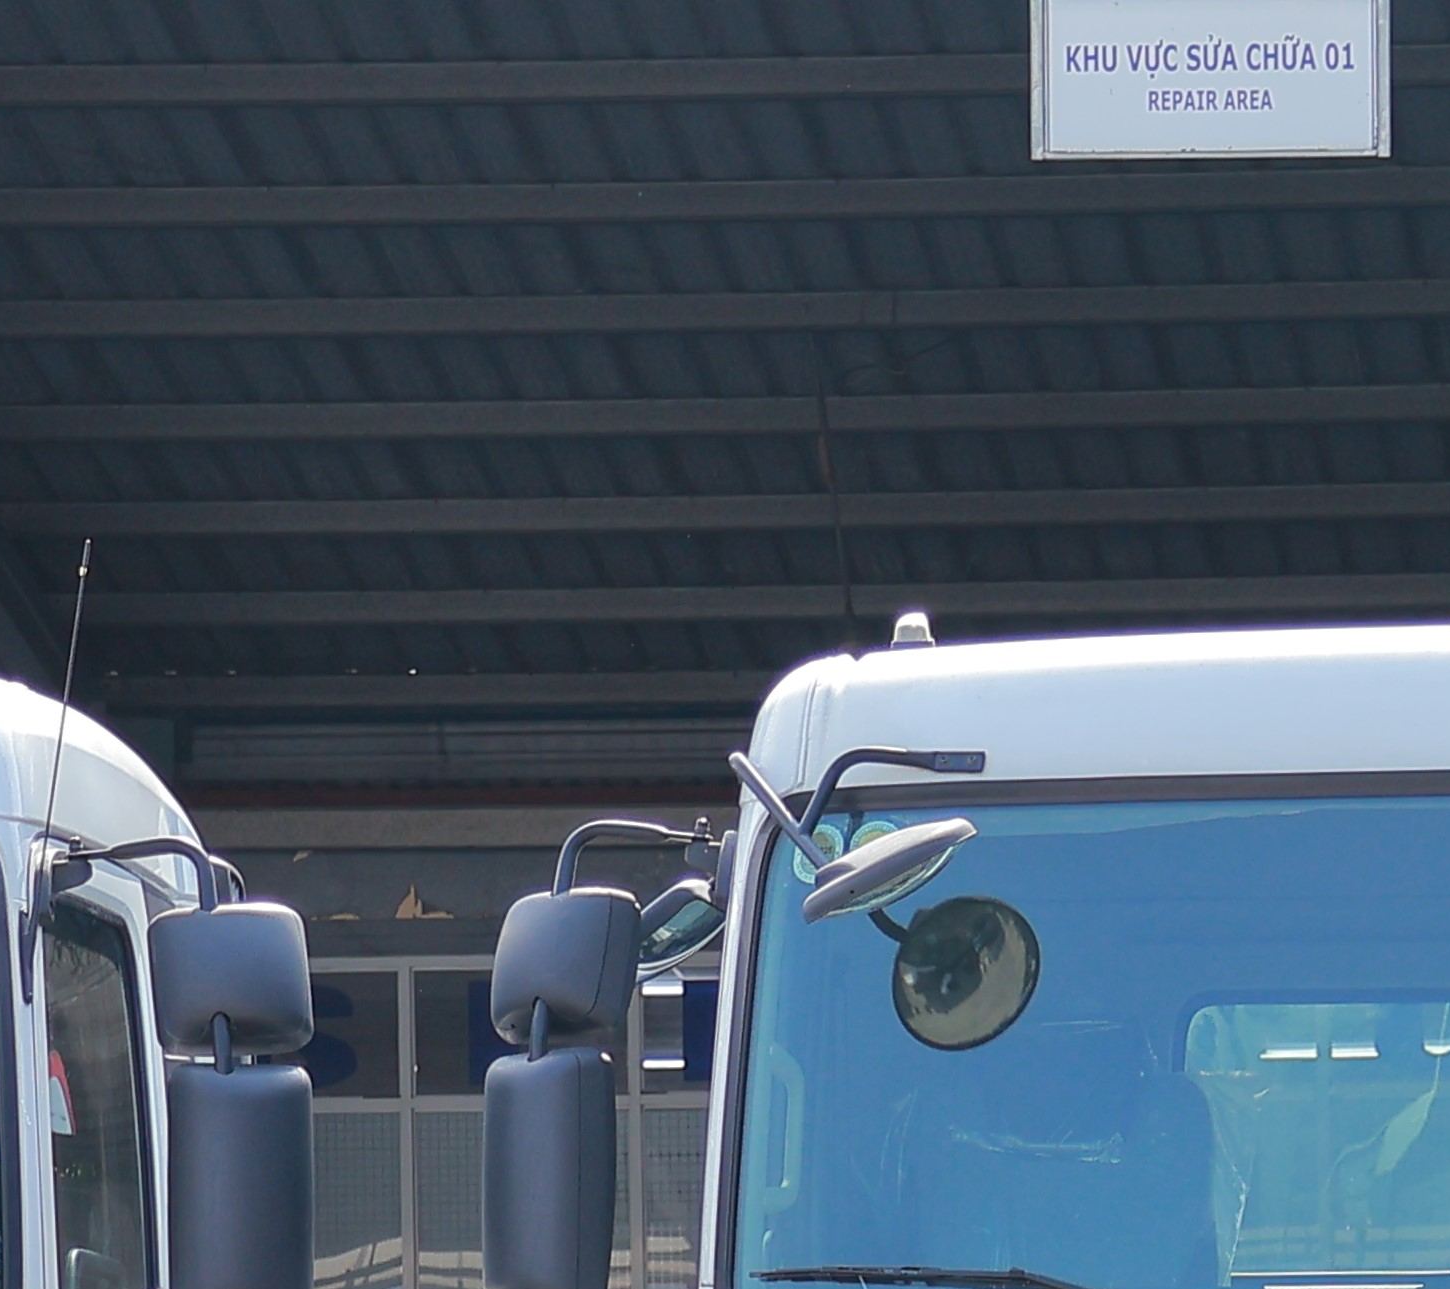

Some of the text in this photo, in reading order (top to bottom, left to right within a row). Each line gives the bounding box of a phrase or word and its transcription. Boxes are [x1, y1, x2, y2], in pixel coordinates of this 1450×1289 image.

[1065, 34, 1355, 79] KHU VỰC SỬA CHỮA 01
[1148, 89, 1273, 112] REPAIR AREA
